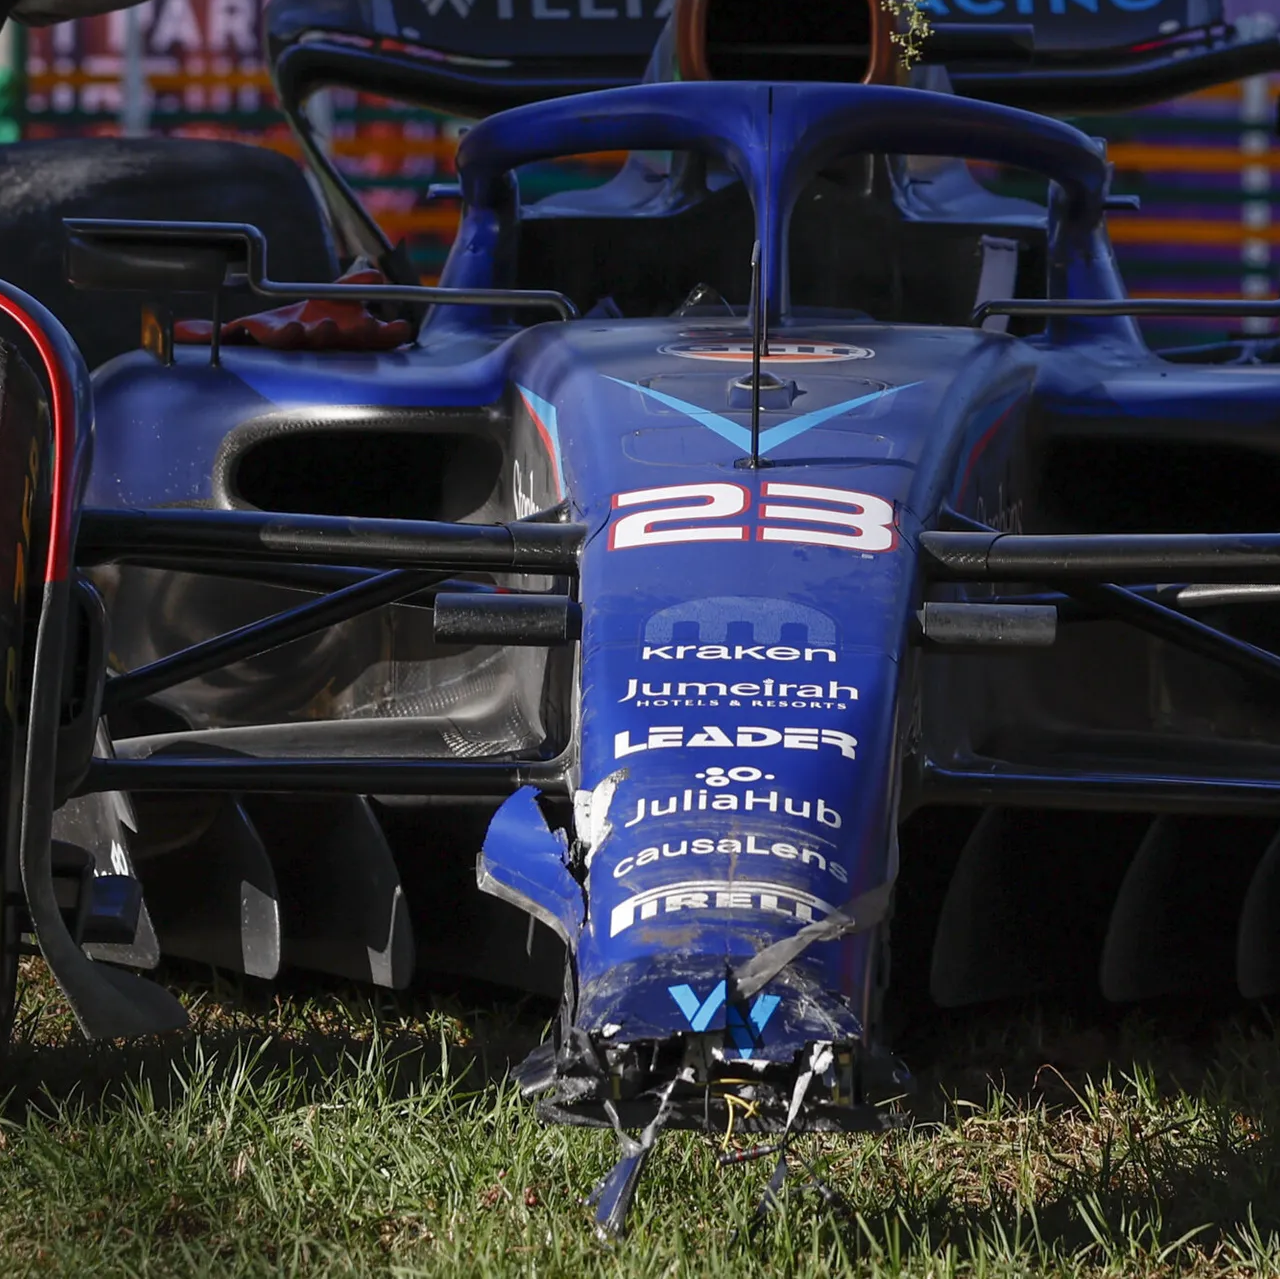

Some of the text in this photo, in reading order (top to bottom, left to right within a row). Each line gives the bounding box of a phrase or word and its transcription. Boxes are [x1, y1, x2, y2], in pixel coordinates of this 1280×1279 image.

[607, 481, 900, 552] 23
[641, 644, 837, 663] kraken
[617, 678, 860, 702] Jumeirah
[636, 699, 848, 711] HOTELS & RESORTS
[614, 725, 859, 760] LEADER
[624, 788, 843, 829] JuliaHub
[612, 834, 849, 884] causaLens
[610, 880, 848, 938] PIRELL
